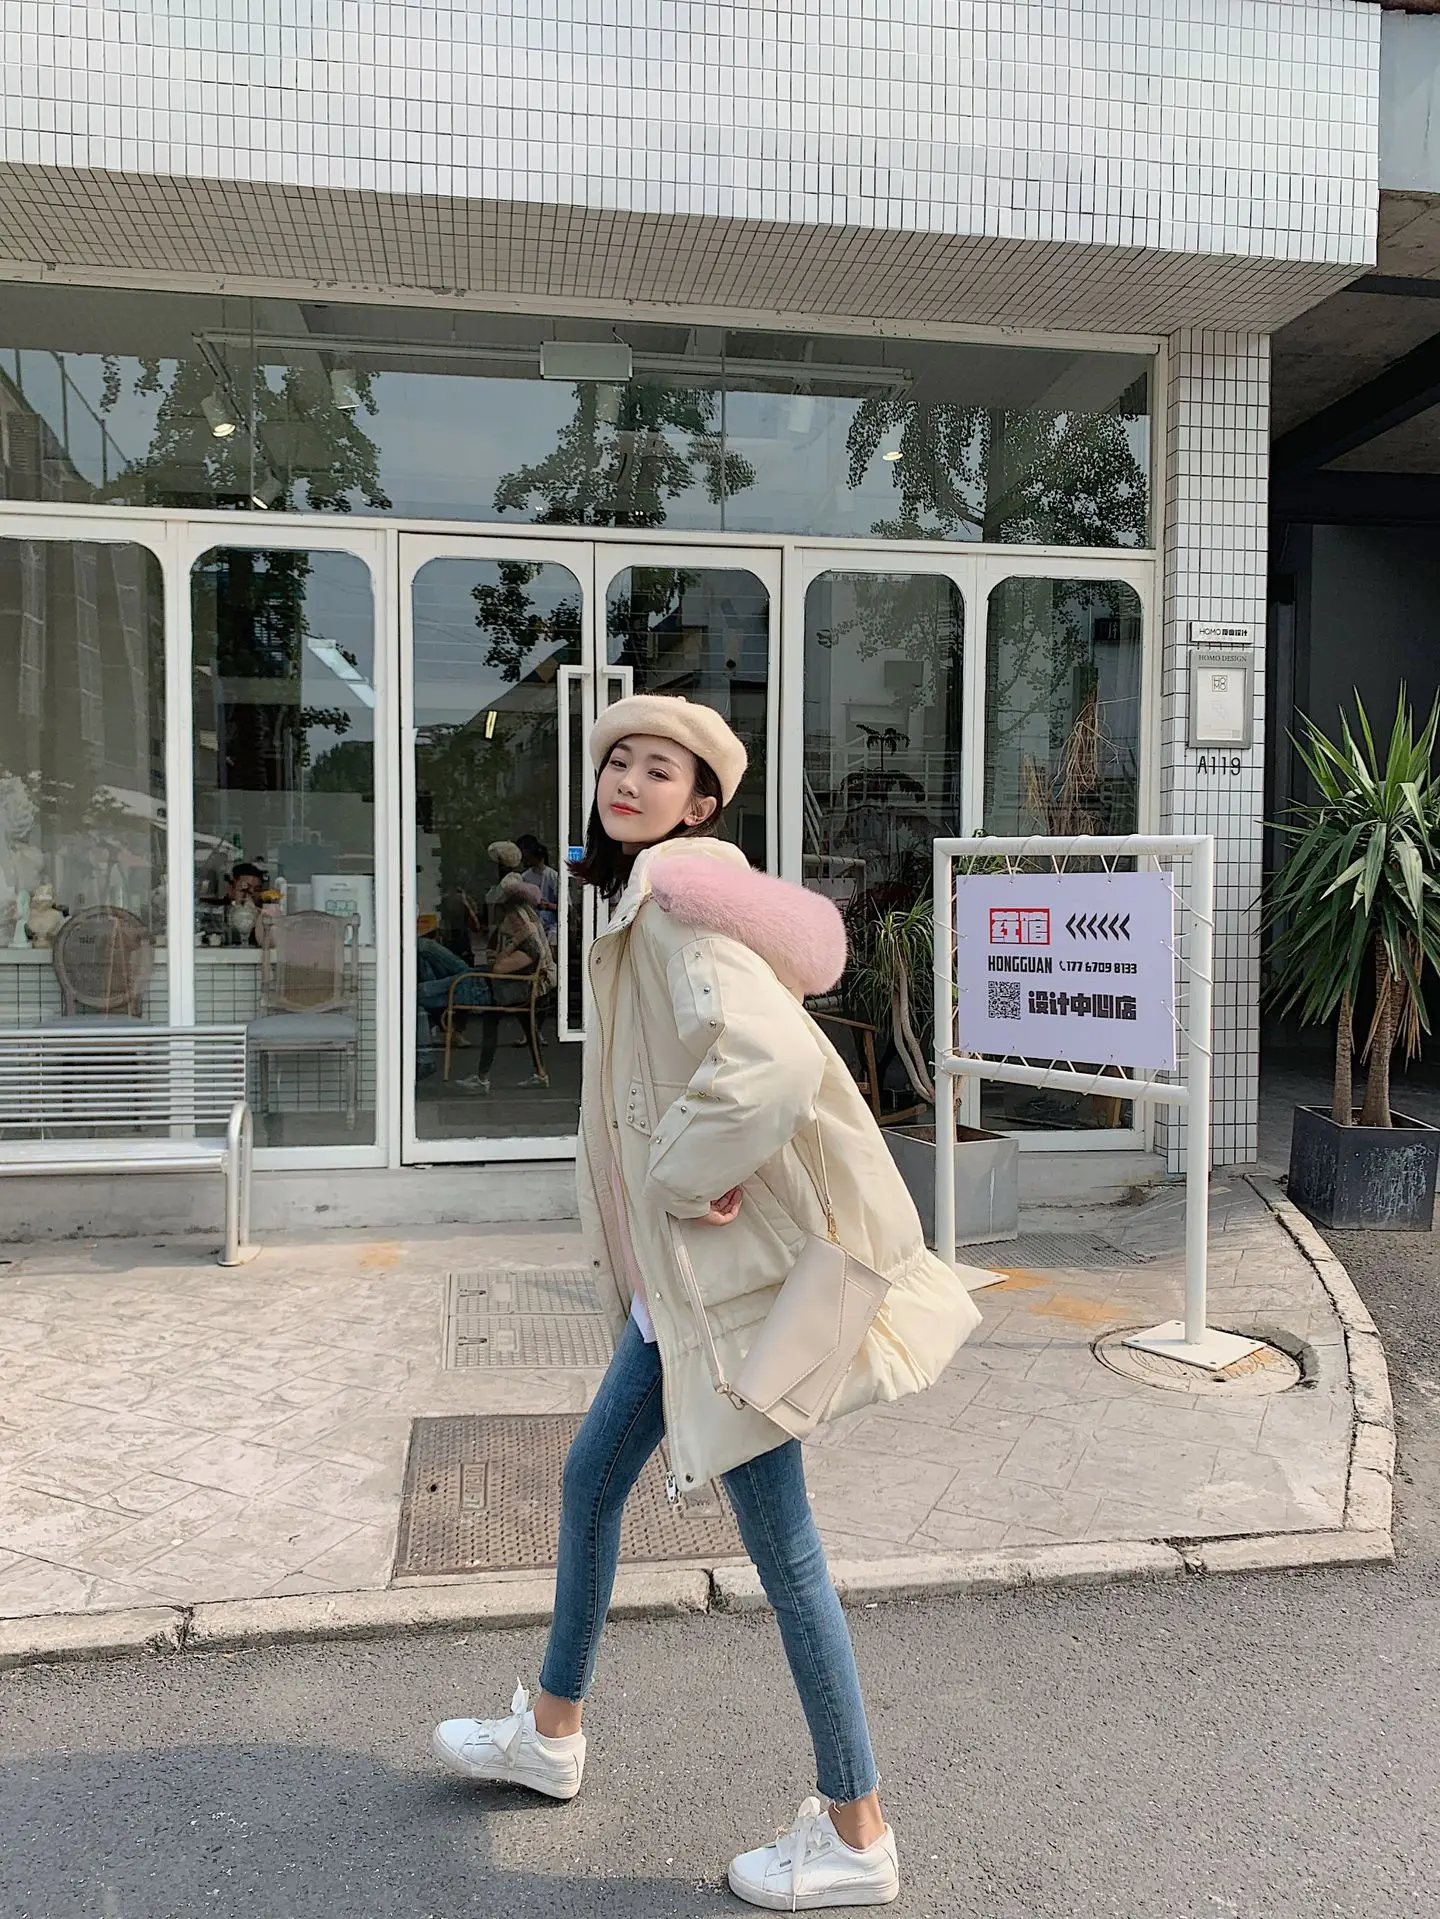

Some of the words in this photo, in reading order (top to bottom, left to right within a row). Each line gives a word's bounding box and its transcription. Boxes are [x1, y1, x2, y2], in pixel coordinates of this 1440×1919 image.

[1199, 628, 1221, 636] HOMO
[1198, 654, 1220, 662] HOMO
[1197, 755, 1241, 776] A119
[988, 955, 1053, 974] HONGGUAN
[1066, 961, 1083, 972] 177
[1085, 961, 1112, 973] 6709
[1114, 963, 1138, 974] 8133
[1028, 990, 1137, 1020] 设计中心店
